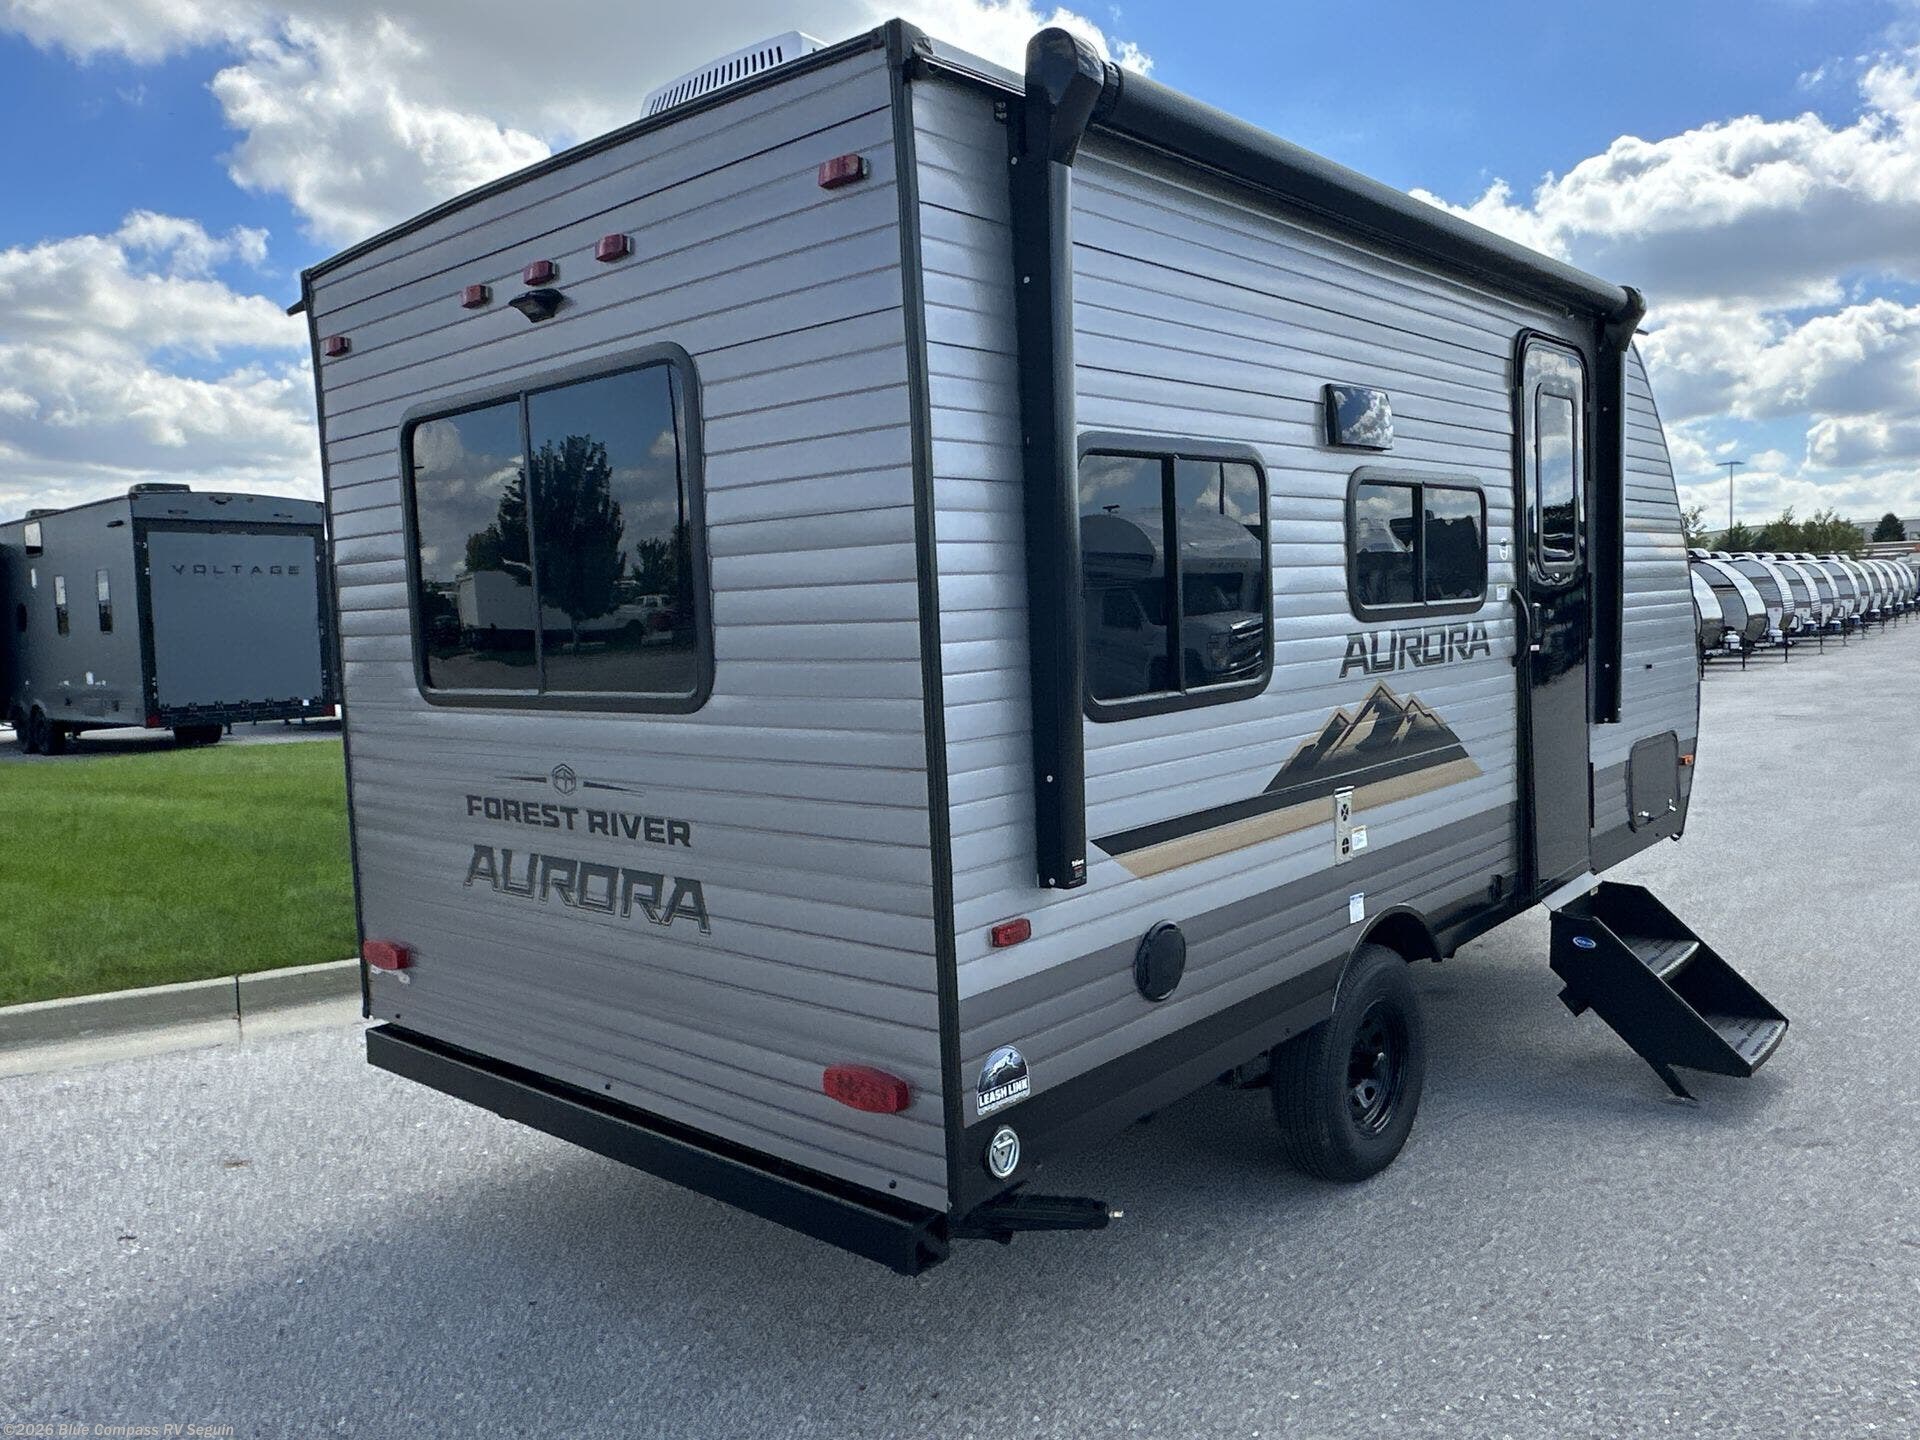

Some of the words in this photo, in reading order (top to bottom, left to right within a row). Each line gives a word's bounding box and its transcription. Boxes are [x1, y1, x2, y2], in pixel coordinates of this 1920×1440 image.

[172, 564, 301, 576] VOLTAGE
[1339, 620, 1491, 678] AURORA
[466, 795, 579, 830] FOREST
[586, 809, 692, 848] RIVER
[463, 844, 712, 935] AURORA
[979, 1086, 1007, 1107] LEASH
[1008, 1078, 1028, 1096] LINK
